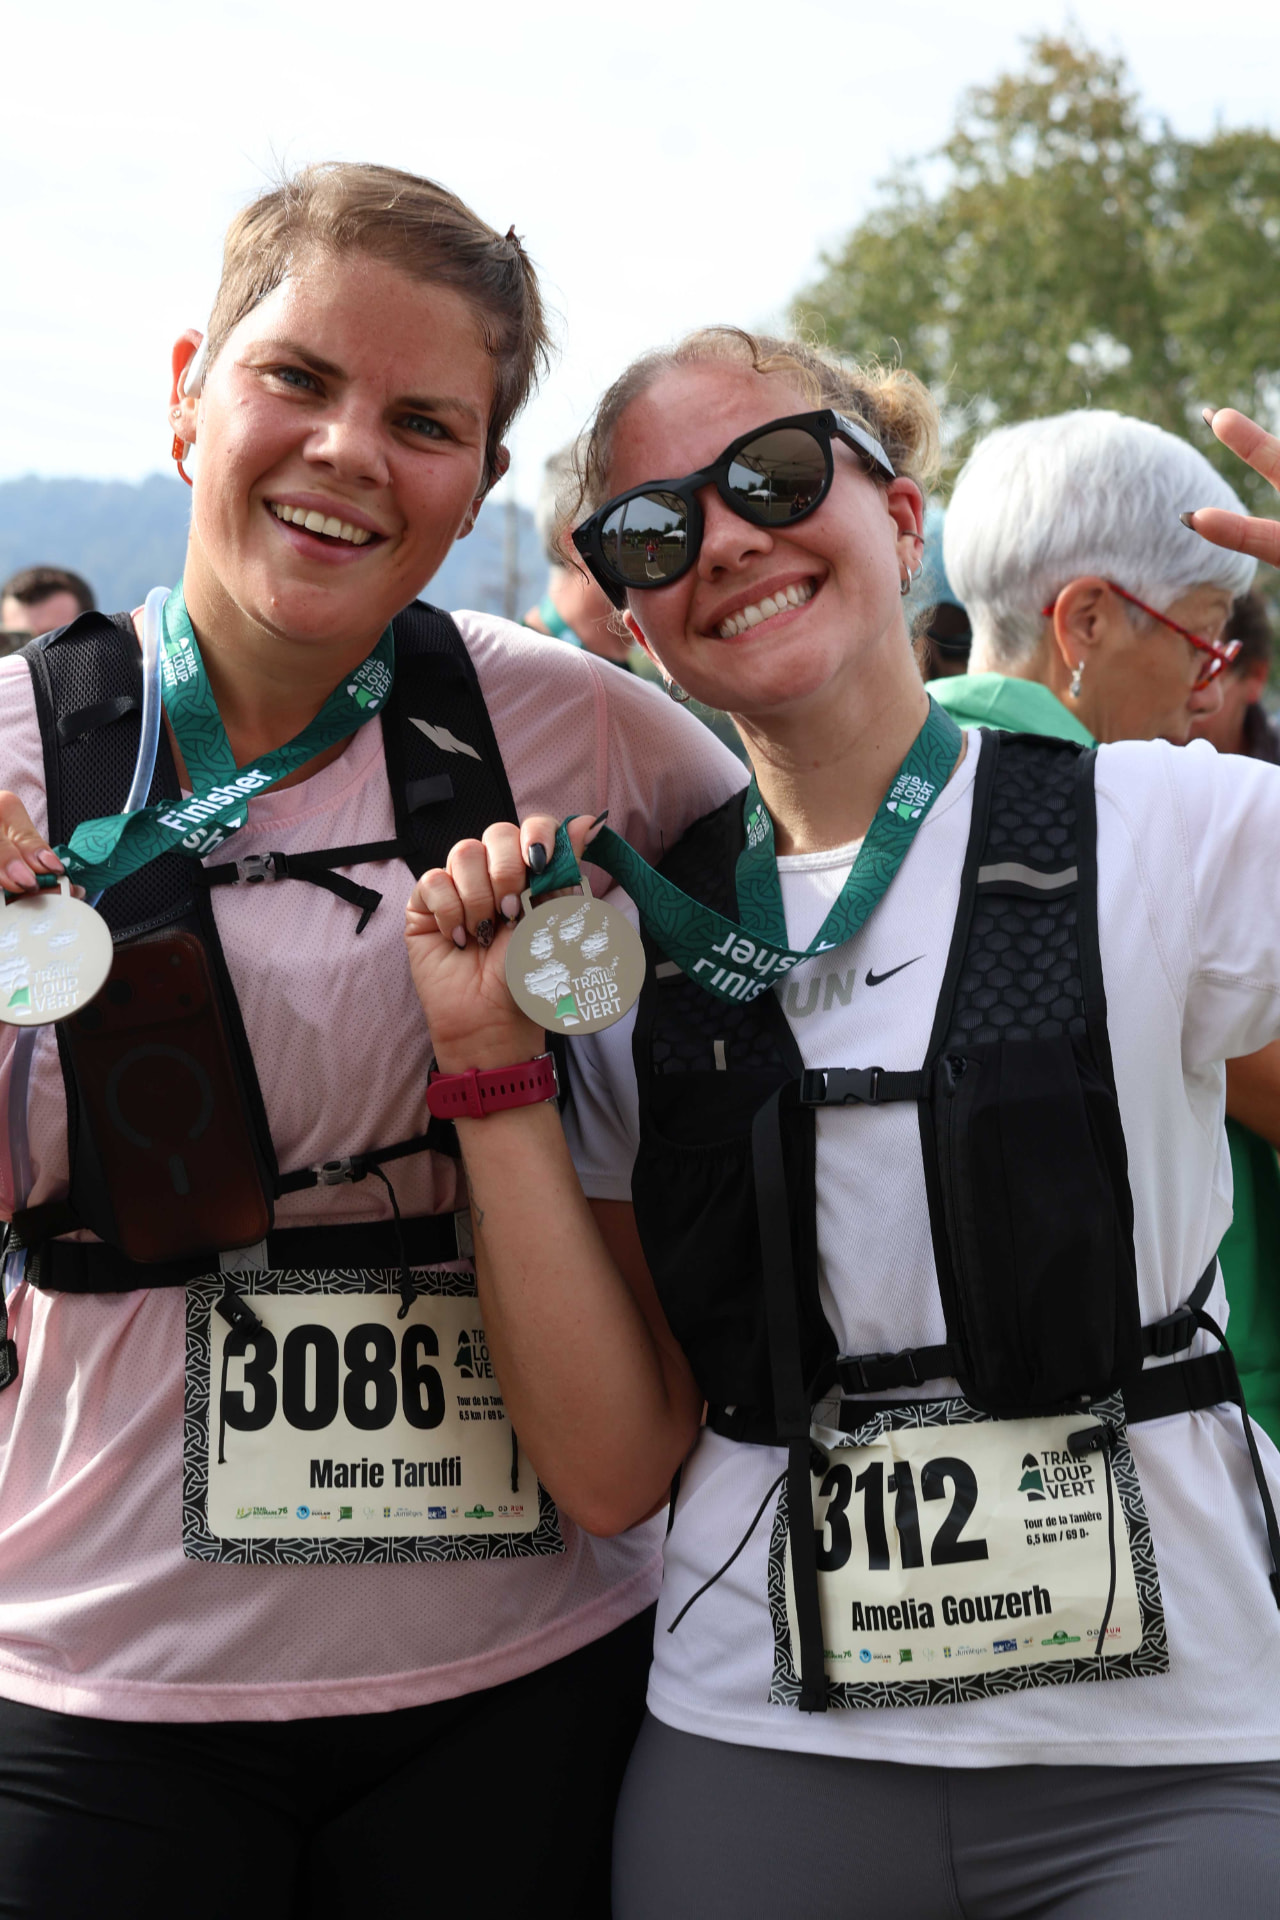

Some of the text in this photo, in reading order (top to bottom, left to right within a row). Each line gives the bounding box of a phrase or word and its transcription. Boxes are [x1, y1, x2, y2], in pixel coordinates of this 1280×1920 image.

[162, 657, 178, 688] VERT
[172, 651, 189, 683] LOUP
[183, 646, 199, 678] TRAIL
[353, 657, 377, 684] TRAIL
[361, 660, 386, 692] LOUP
[372, 668, 393, 698] VERT
[157, 769, 273, 832] Finisher
[890, 774, 912, 800] TRAIL
[900, 776, 922, 806] LOUP
[912, 780, 936, 807] VERT
[32, 965, 73, 984] TRAIL
[33, 975, 79, 998] LOUP
[571, 970, 613, 991] TRAIL
[33, 989, 80, 1013] VERT
[574, 983, 618, 1007] LOUP
[776, 968, 857, 1019] UN
[578, 997, 621, 1022] VERT
[223, 1322, 446, 1432] 3086
[309, 1455, 462, 1489] Marie Taruffi
[1043, 1464, 1092, 1484] LOUP
[1046, 1479, 1096, 1500] VERT
[814, 1456, 989, 1573] 3112
[1024, 1511, 1102, 1530] Tour de la Tanière
[1026, 1532, 1041, 1546] 6,5
[1042, 1531, 1057, 1543] km
[1065, 1528, 1078, 1540] 69
[851, 1585, 1052, 1632] Amelia Gouzerh
